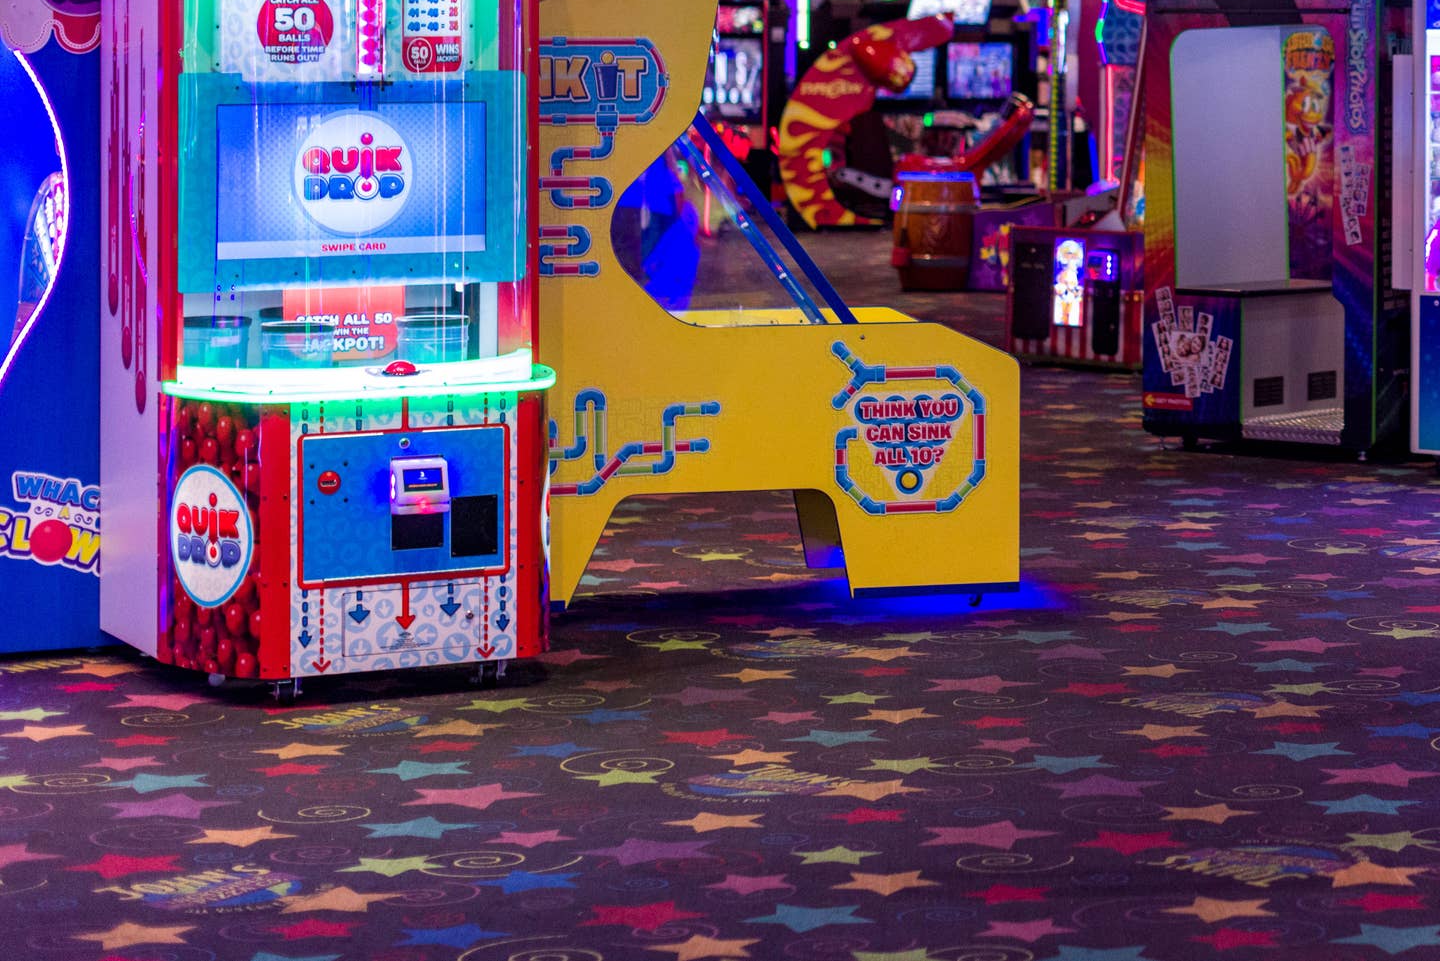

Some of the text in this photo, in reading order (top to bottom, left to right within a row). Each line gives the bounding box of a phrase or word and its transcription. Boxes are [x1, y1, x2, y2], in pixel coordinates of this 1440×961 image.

[274, 7, 315, 32] 50
[279, 34, 310, 42] BALLS
[270, 54, 320, 62] RUNS OUT!
[411, 44, 459, 60] 50 WINS
[436, 54, 460, 62] JACKPOT
[302, 132, 402, 174] QUIK
[303, 173, 405, 200] DROP
[322, 243, 386, 252] SWIPE CARD
[343, 314, 370, 325] ALL
[374, 312, 393, 324] 50
[860, 399, 958, 418] THINK YOU
[866, 423, 952, 442] CAN SINK
[874, 447, 945, 465] ALL 10?
[16, 474, 100, 509] WHAC
[58, 506, 70, 519] A
[177, 493, 239, 545] QUIK
[178, 534, 241, 568] DROP
